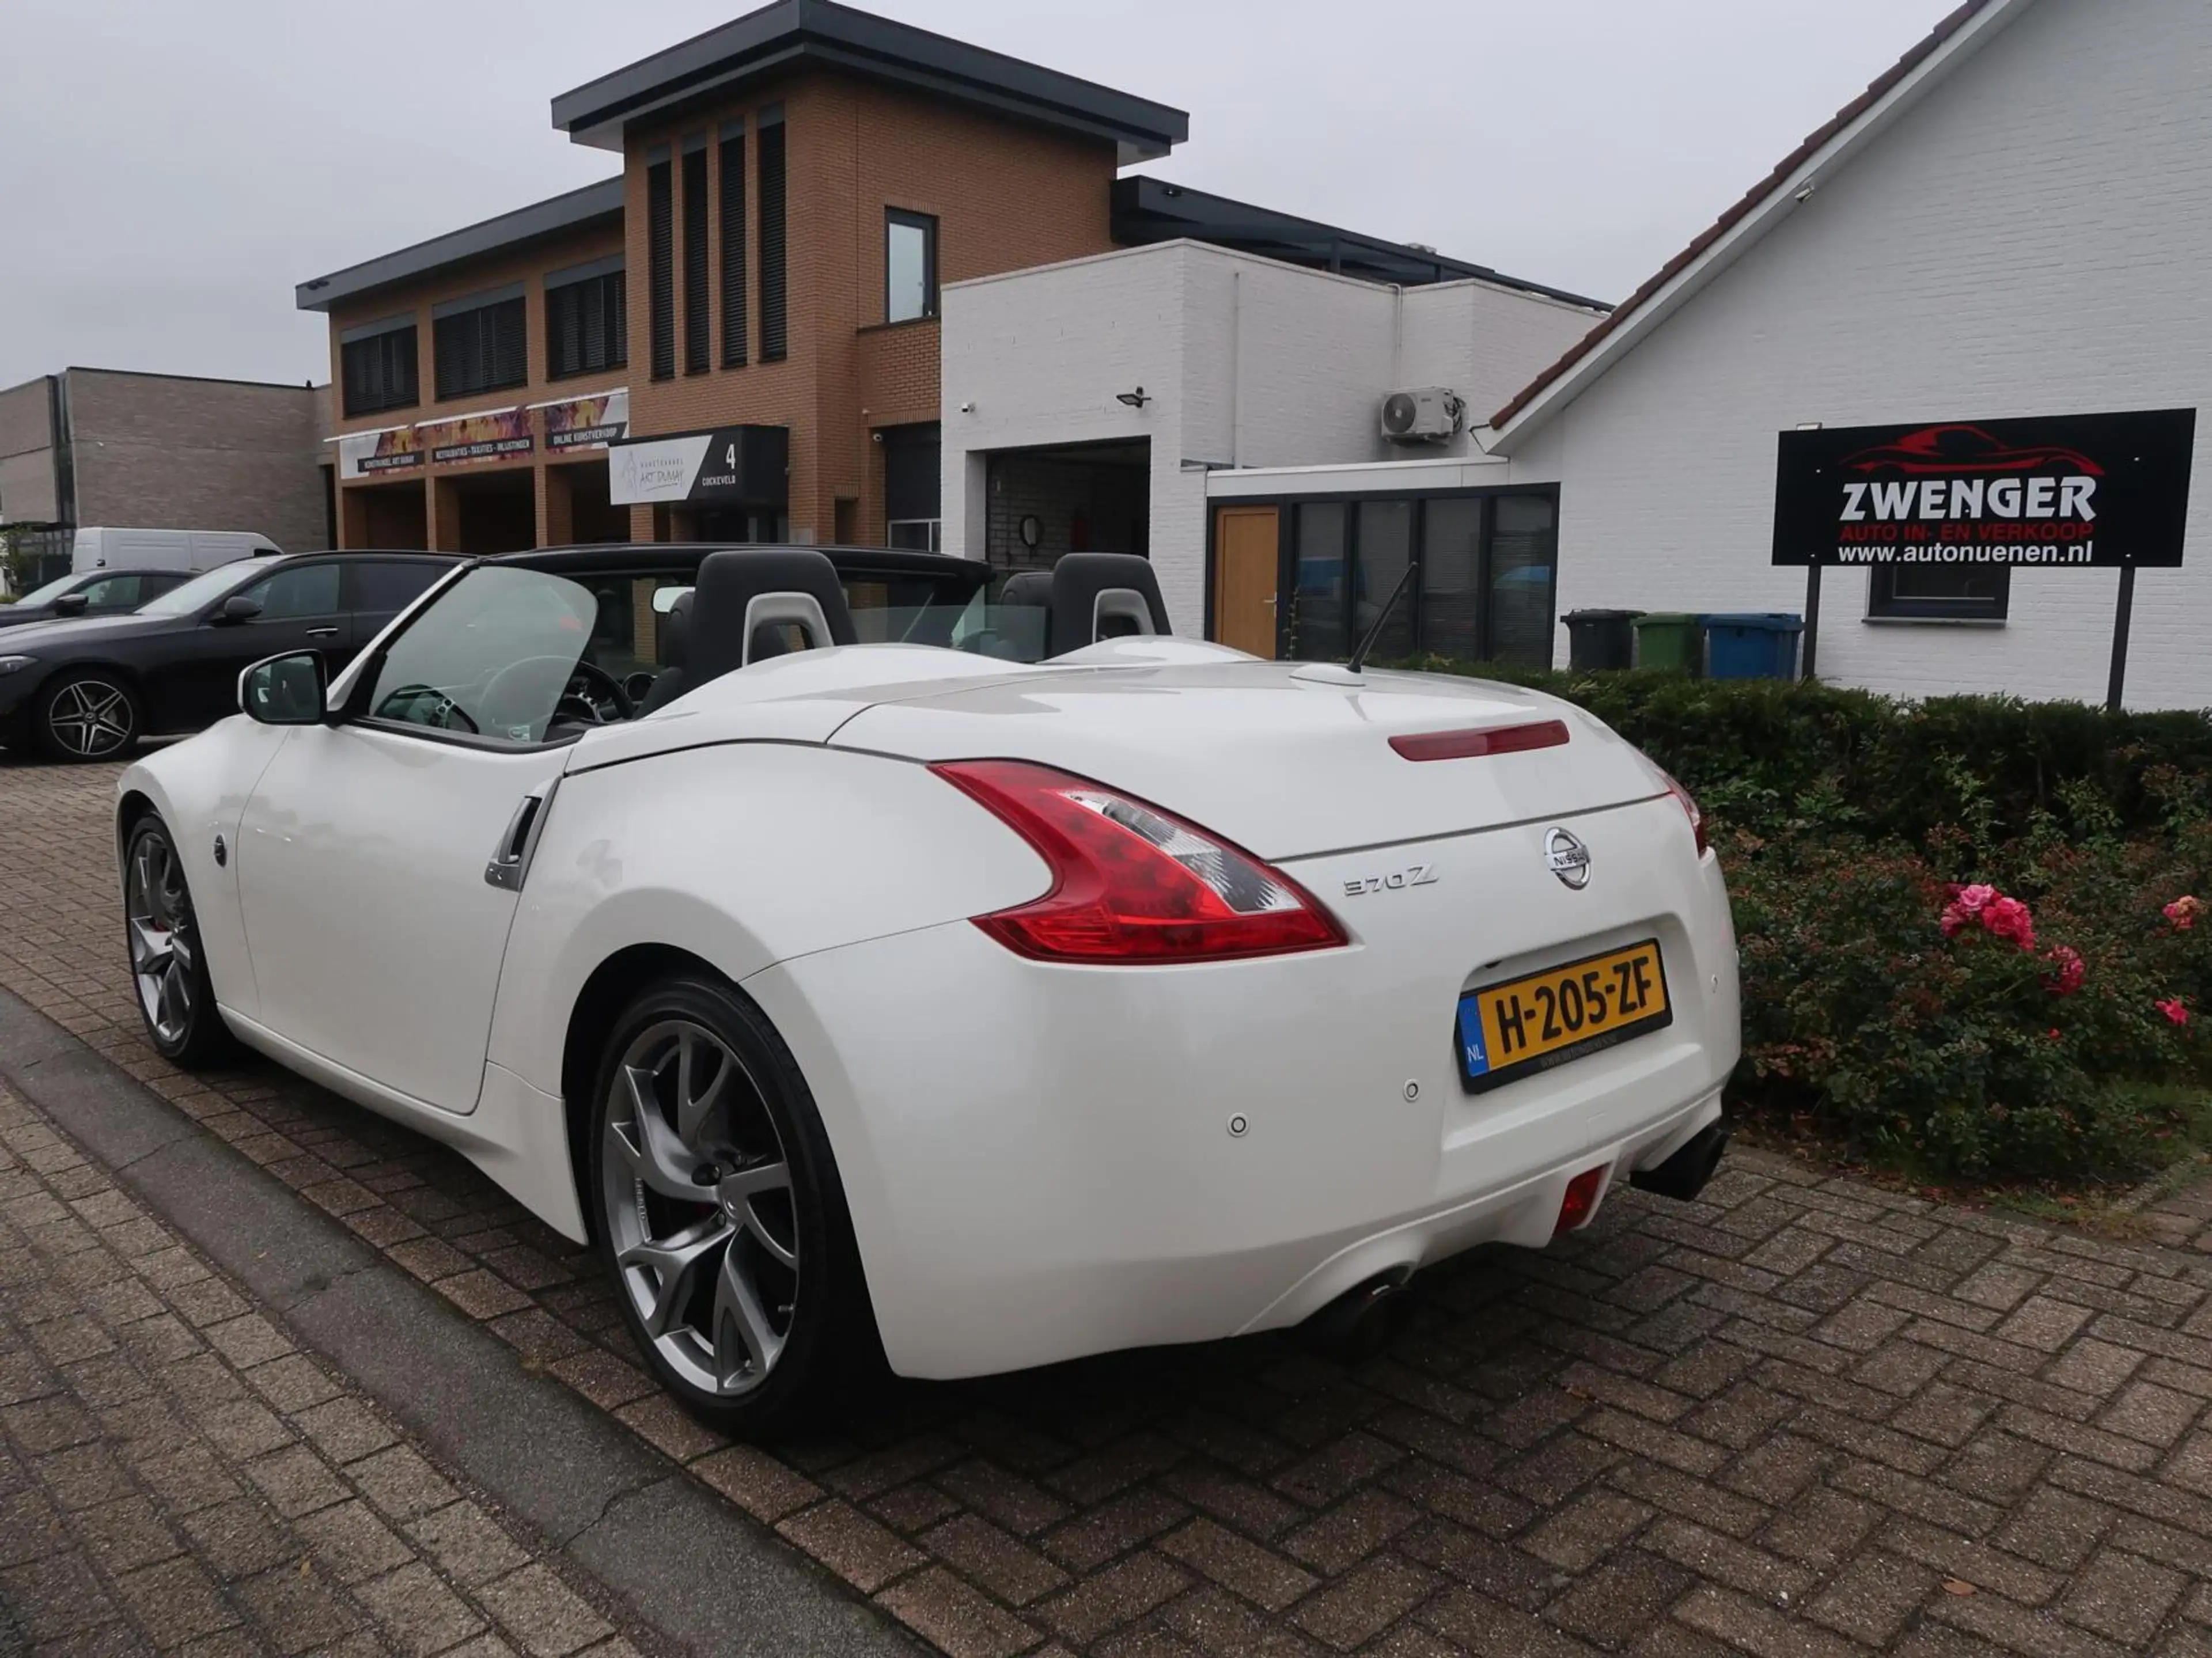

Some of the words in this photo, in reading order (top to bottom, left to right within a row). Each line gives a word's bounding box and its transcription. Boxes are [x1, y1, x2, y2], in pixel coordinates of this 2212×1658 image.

[726, 443, 736, 469] 4
[1839, 476, 2097, 522] ZWENGER
[1839, 523, 1897, 542] AUTO
[1904, 523, 1934, 541] IN-
[1940, 522, 1971, 541] EN
[1978, 522, 2095, 541] VERKOOP
[1838, 540, 2093, 563] www.autonuenen.nl
[1343, 864, 1440, 896] 370Z
[1495, 956, 1652, 1054] H-205-ZF
[1467, 1043, 1484, 1063] NL
